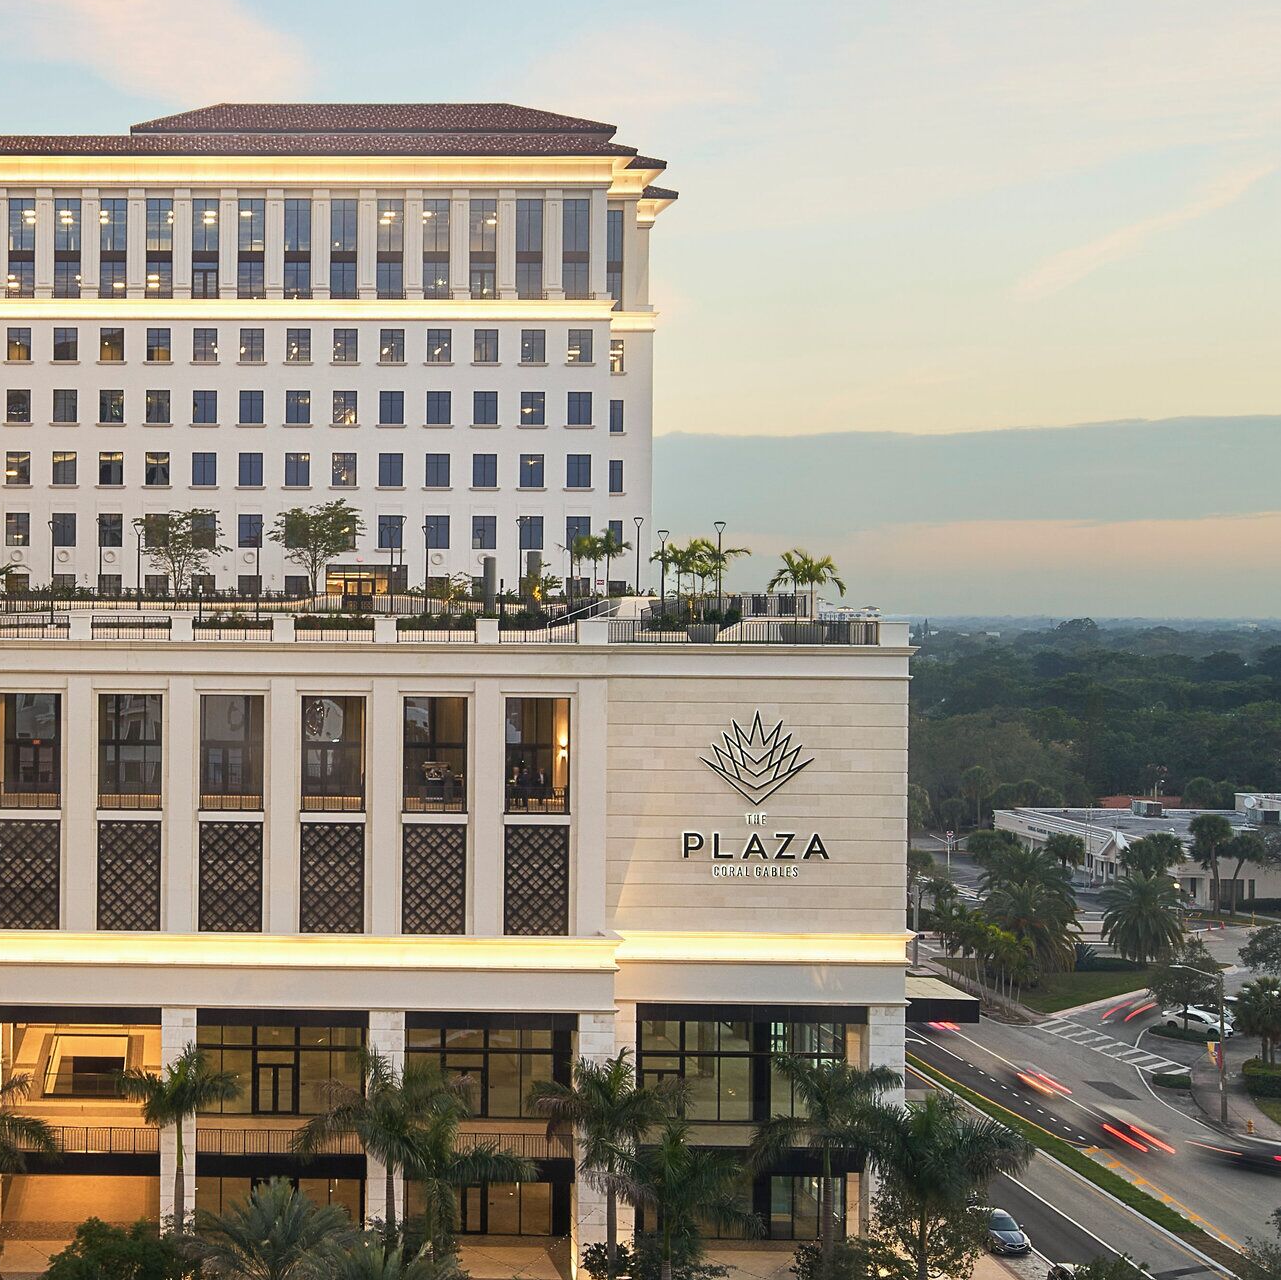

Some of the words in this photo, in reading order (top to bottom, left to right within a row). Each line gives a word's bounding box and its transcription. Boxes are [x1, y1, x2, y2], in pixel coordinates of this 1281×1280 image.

[746, 813, 767, 825] THE
[682, 831, 830, 860] PLAZA
[713, 866, 750, 877] CORAL
[755, 866, 798, 877] GABLES
